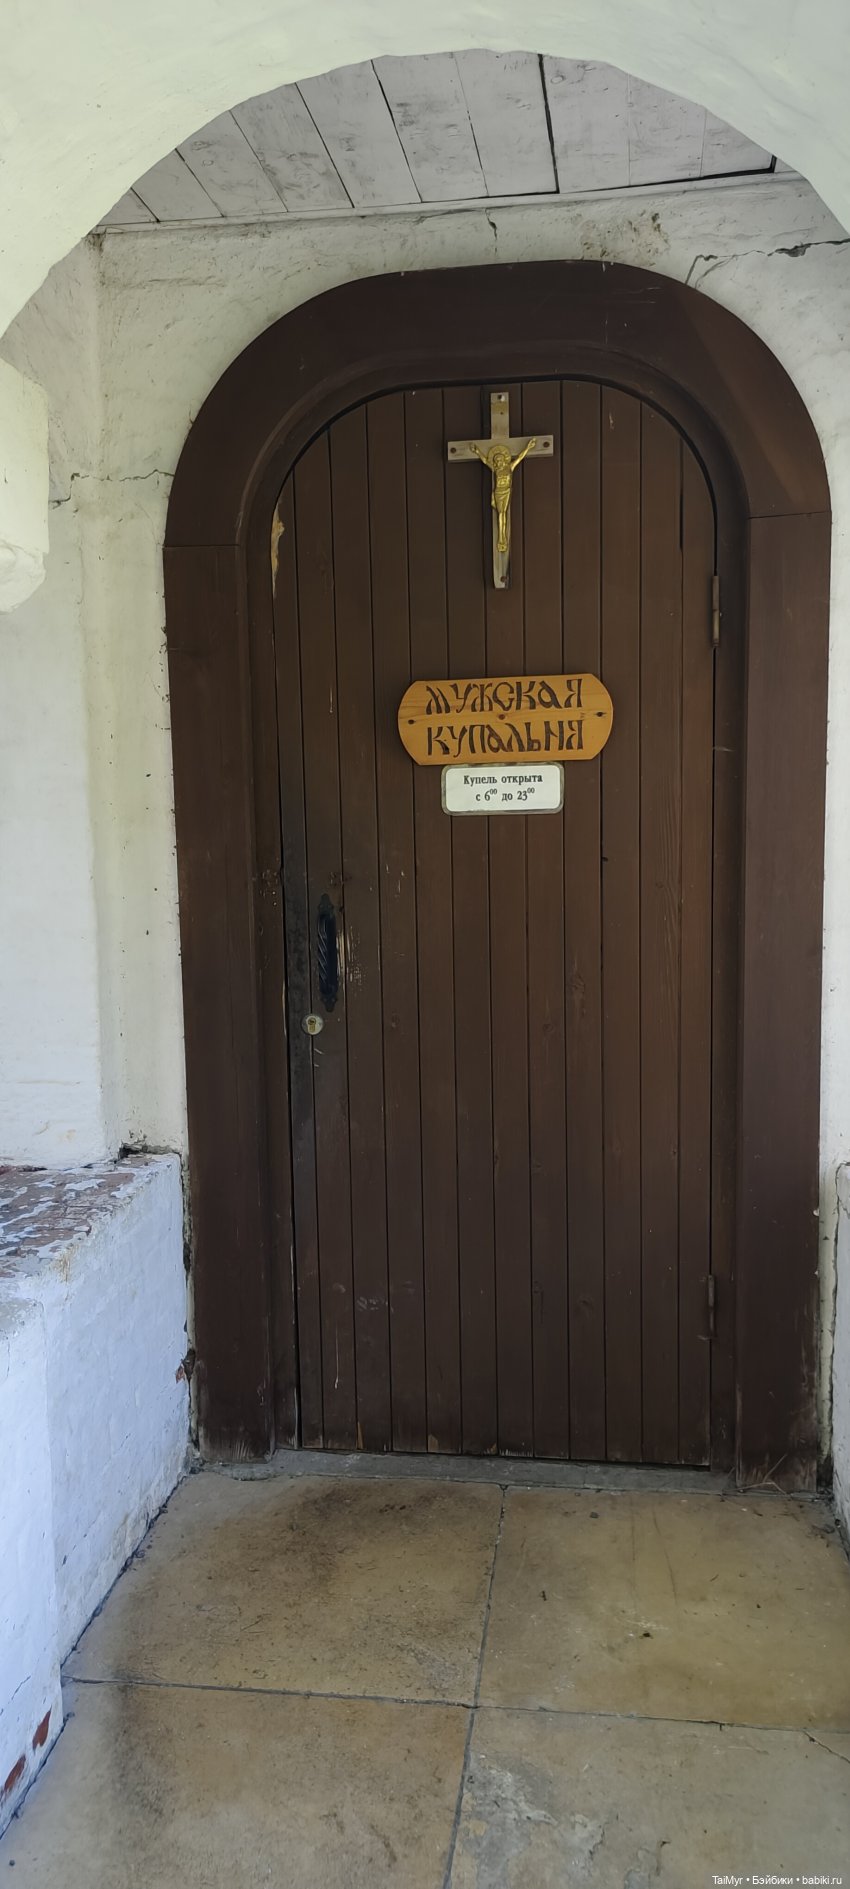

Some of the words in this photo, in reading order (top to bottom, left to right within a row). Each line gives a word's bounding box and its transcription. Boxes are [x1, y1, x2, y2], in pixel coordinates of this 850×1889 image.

[463, 774, 498, 786] Купель
[501, 774, 543, 785] открыта
[501, 792, 513, 801] до
